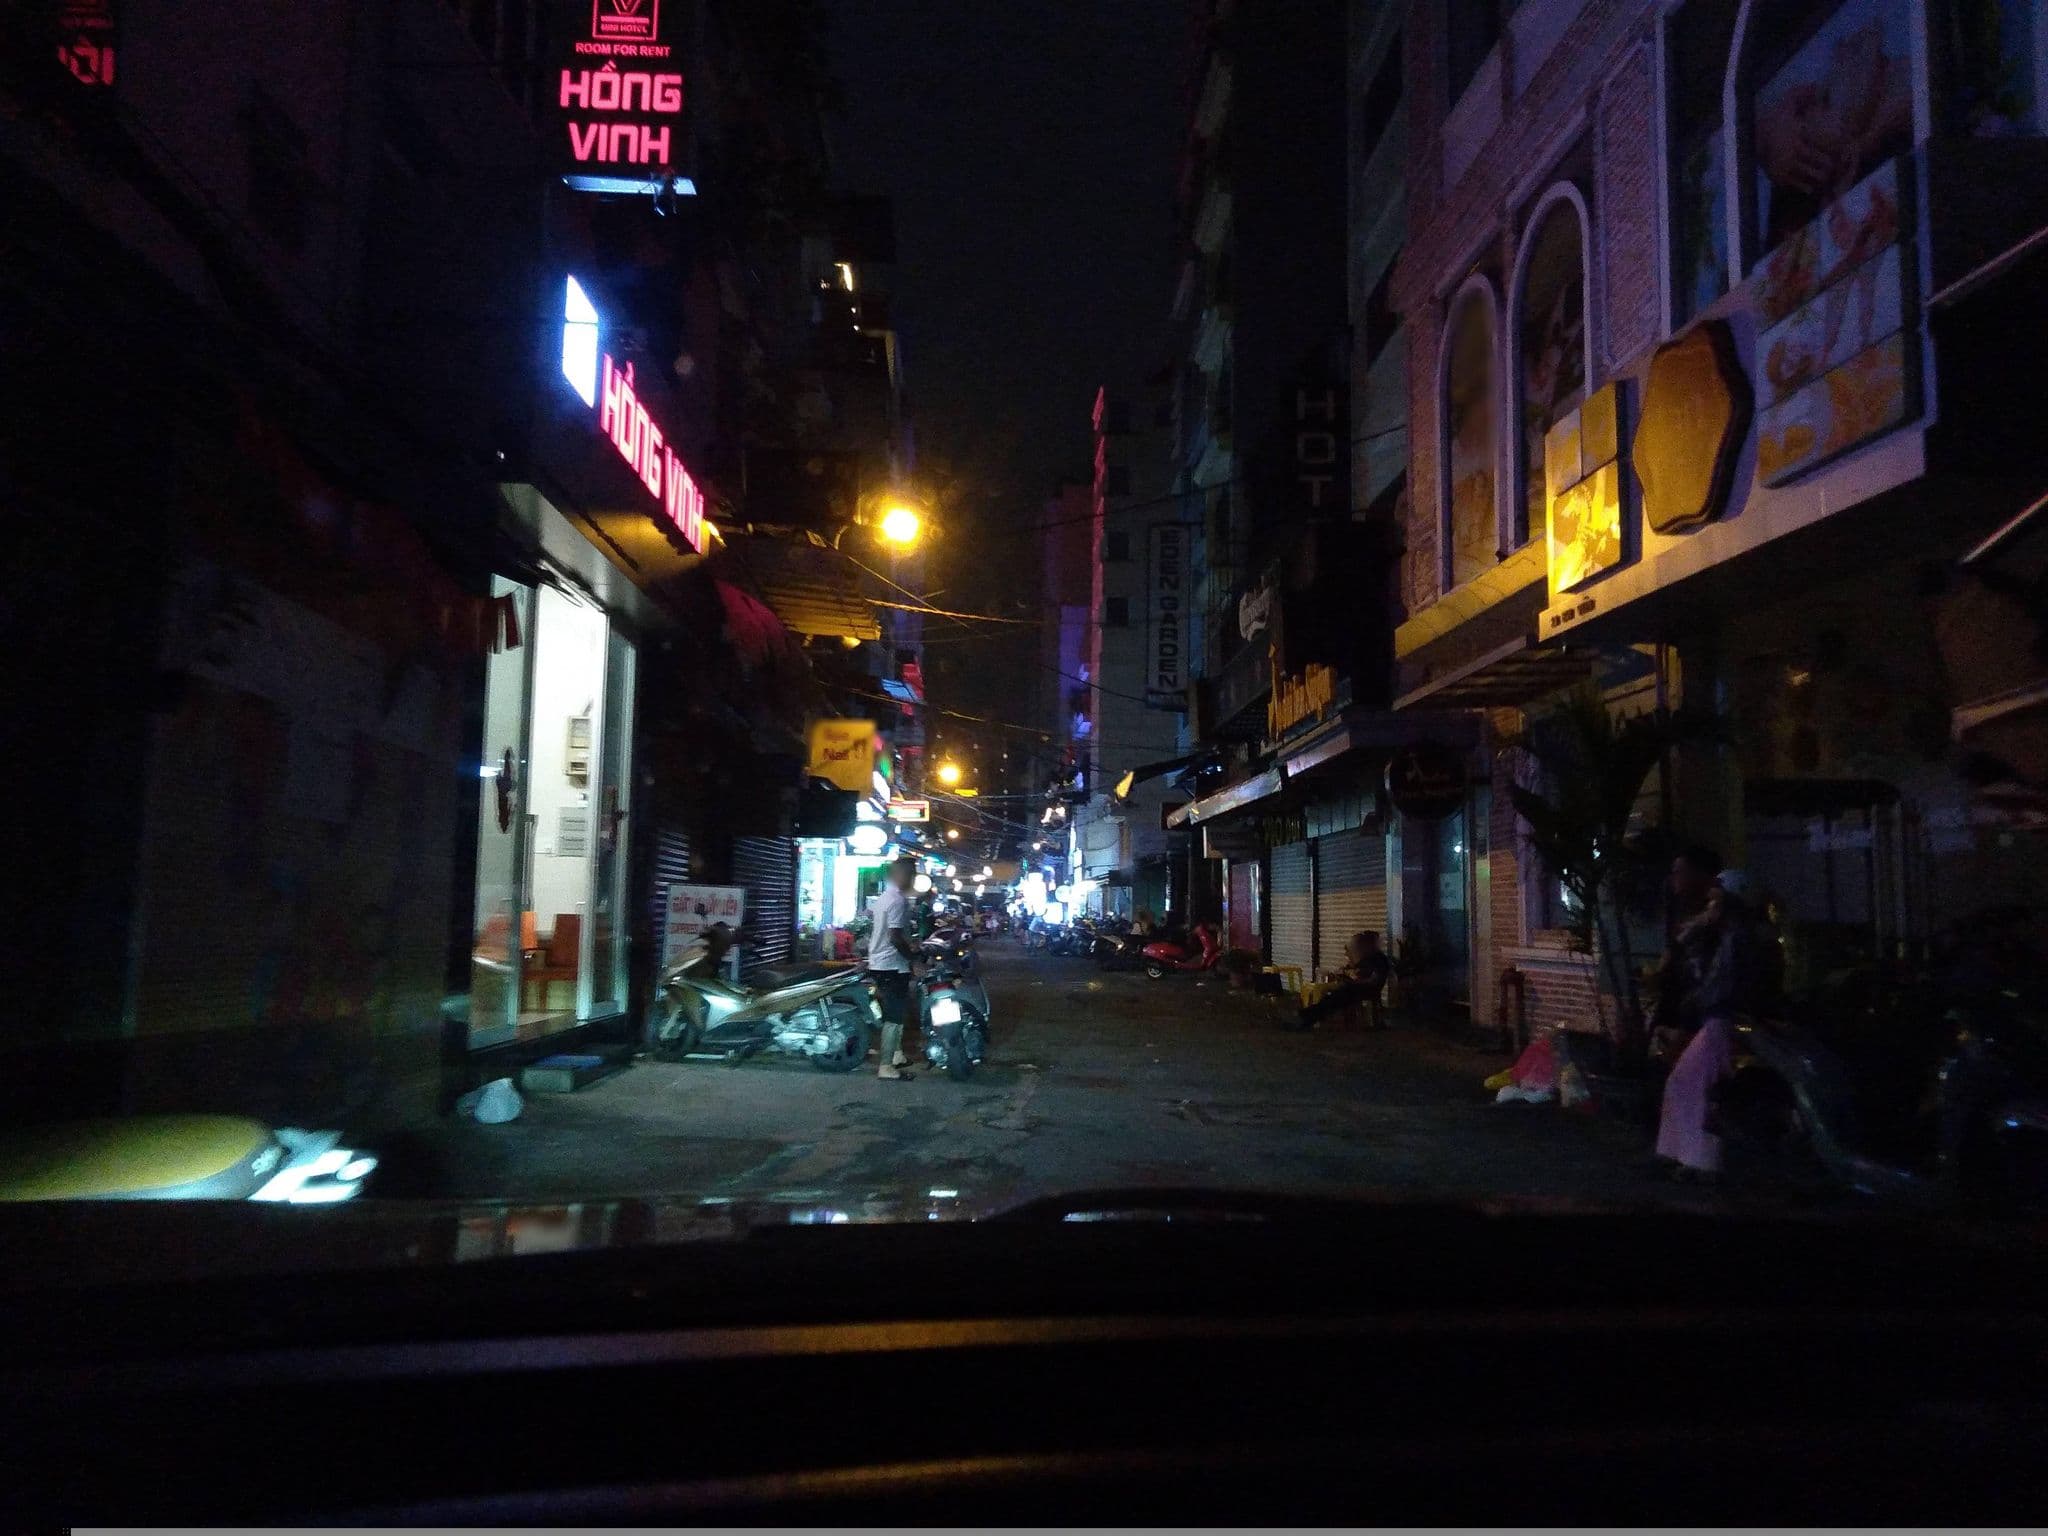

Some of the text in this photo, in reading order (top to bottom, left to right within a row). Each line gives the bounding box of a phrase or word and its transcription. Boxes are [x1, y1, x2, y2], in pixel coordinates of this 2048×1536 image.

[575, 42, 671, 57] ROOM FOR RENT
[560, 58, 684, 113] HỒNG
[567, 121, 671, 166] VINH
[664, 444, 704, 556] VINH
[1158, 529, 1180, 689] EDEN GARDEN
